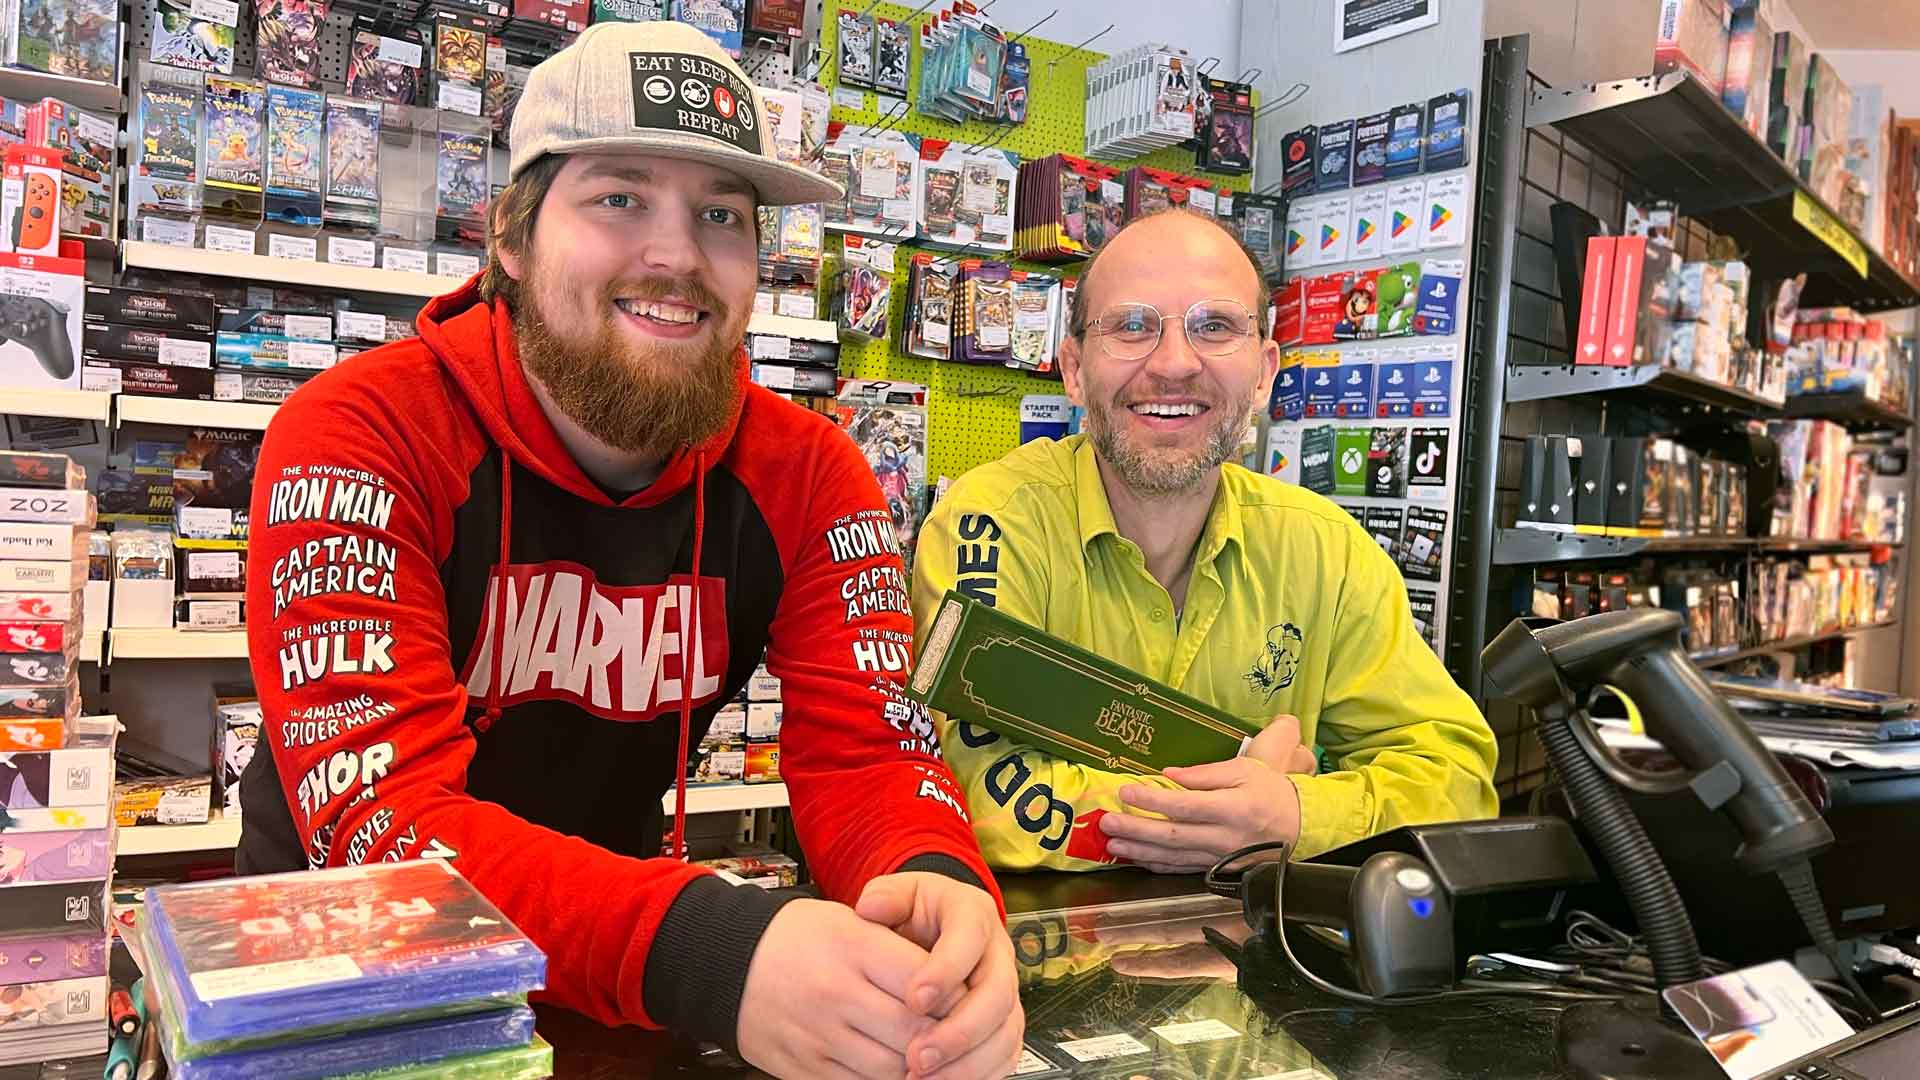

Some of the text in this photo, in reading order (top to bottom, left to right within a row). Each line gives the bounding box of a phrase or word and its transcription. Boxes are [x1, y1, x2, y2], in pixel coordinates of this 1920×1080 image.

[633, 56, 753, 105] EAT SLEEP ROCK
[676, 109, 740, 141] REPEAT
[1025, 404, 1060, 412] STARTER
[206, 431, 250, 441] MAGIC
[282, 465, 385, 487] THE INVINCIBLE
[268, 478, 329, 527] IRON
[329, 479, 396, 531] MAN
[834, 515, 852, 527] THE
[1368, 519, 1399, 528] ROBLOX
[1408, 518, 1443, 531] ROBLOX
[826, 521, 881, 562] IRON
[272, 535, 397, 588] CAPTAIN
[274, 565, 397, 620] AMERICA
[1411, 602, 1433, 612] BLOX
[282, 619, 392, 642] THE INCREDIBLE
[466, 572, 720, 712] MARVEL
[859, 629, 878, 639] THE
[279, 633, 395, 690] HULK
[302, 693, 374, 720] AMAZING
[1110, 699, 1154, 725] FANTASTIC
[1094, 706, 1155, 746] BEASTS
[297, 742, 395, 828] THOR
